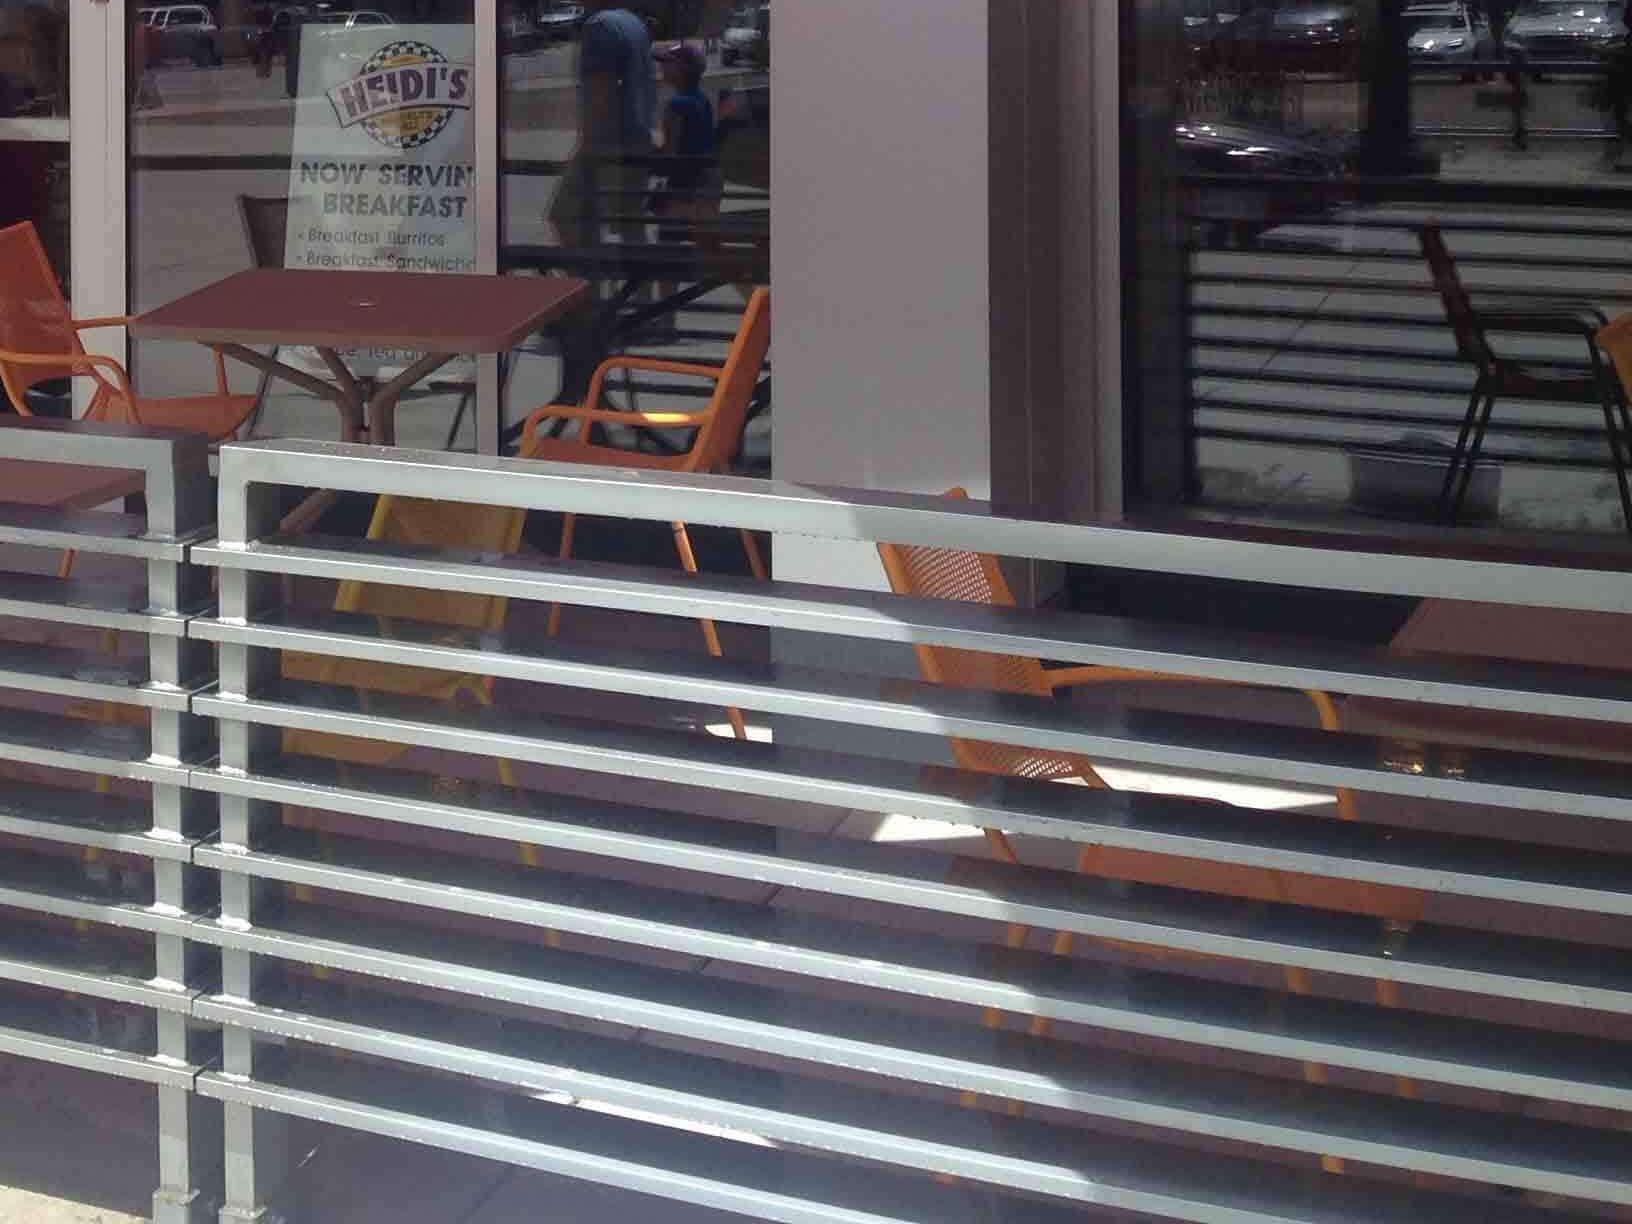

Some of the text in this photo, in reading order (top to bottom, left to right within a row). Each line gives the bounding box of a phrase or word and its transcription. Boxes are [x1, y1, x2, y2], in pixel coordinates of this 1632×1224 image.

[340, 66, 468, 117] HEIDI'S
[300, 161, 367, 184] NOW
[322, 192, 467, 218] BREAKFAST
